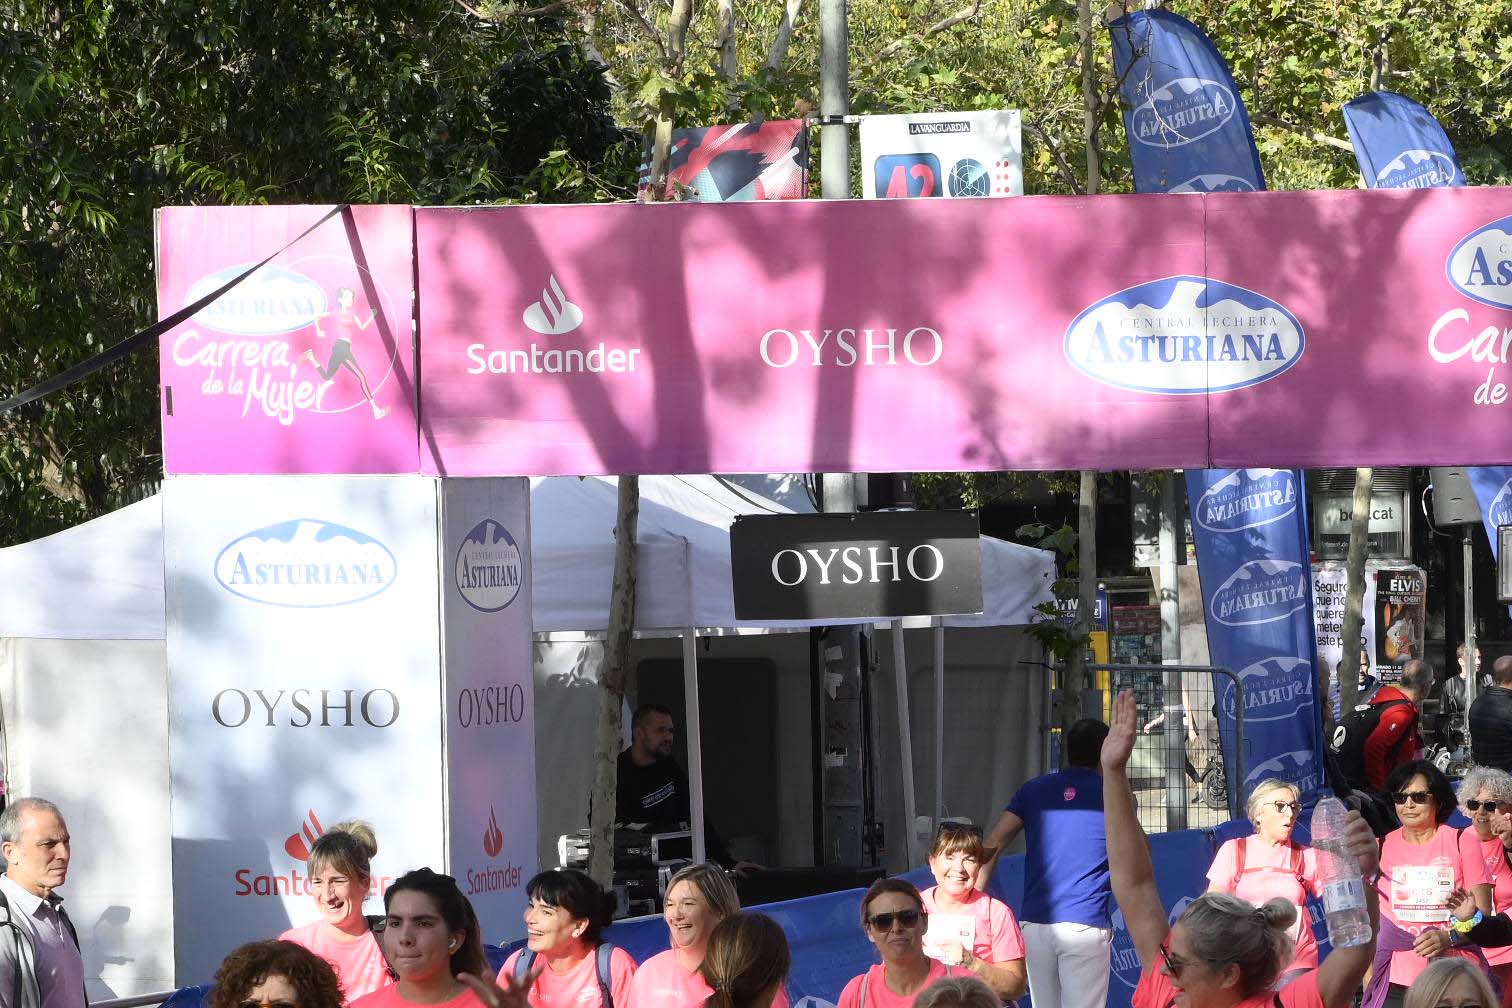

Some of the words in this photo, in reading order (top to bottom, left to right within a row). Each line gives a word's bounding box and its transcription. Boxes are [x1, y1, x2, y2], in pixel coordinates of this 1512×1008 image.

[1087, 320, 1286, 363] ASTURIANA
[1120, 317, 1193, 329] CENTRAL
[1203, 316, 1277, 329] LECHERA
[172, 330, 291, 368] Carrera
[466, 343, 641, 375] Santander
[758, 327, 944, 368] OYSHO
[202, 369, 224, 395] de
[228, 370, 245, 395] la
[241, 366, 336, 426] Mujer
[1474, 367, 1508, 405] de
[229, 551, 386, 586] ASTURIANA
[461, 564, 519, 591] ASTURIANA
[771, 544, 944, 587] OYSHO
[1390, 579, 1420, 592] ELVIS
[211, 688, 401, 728] OYSHO
[458, 683, 525, 728] OYSHO
[235, 868, 391, 898] Santer
[467, 861, 523, 896] Santander
